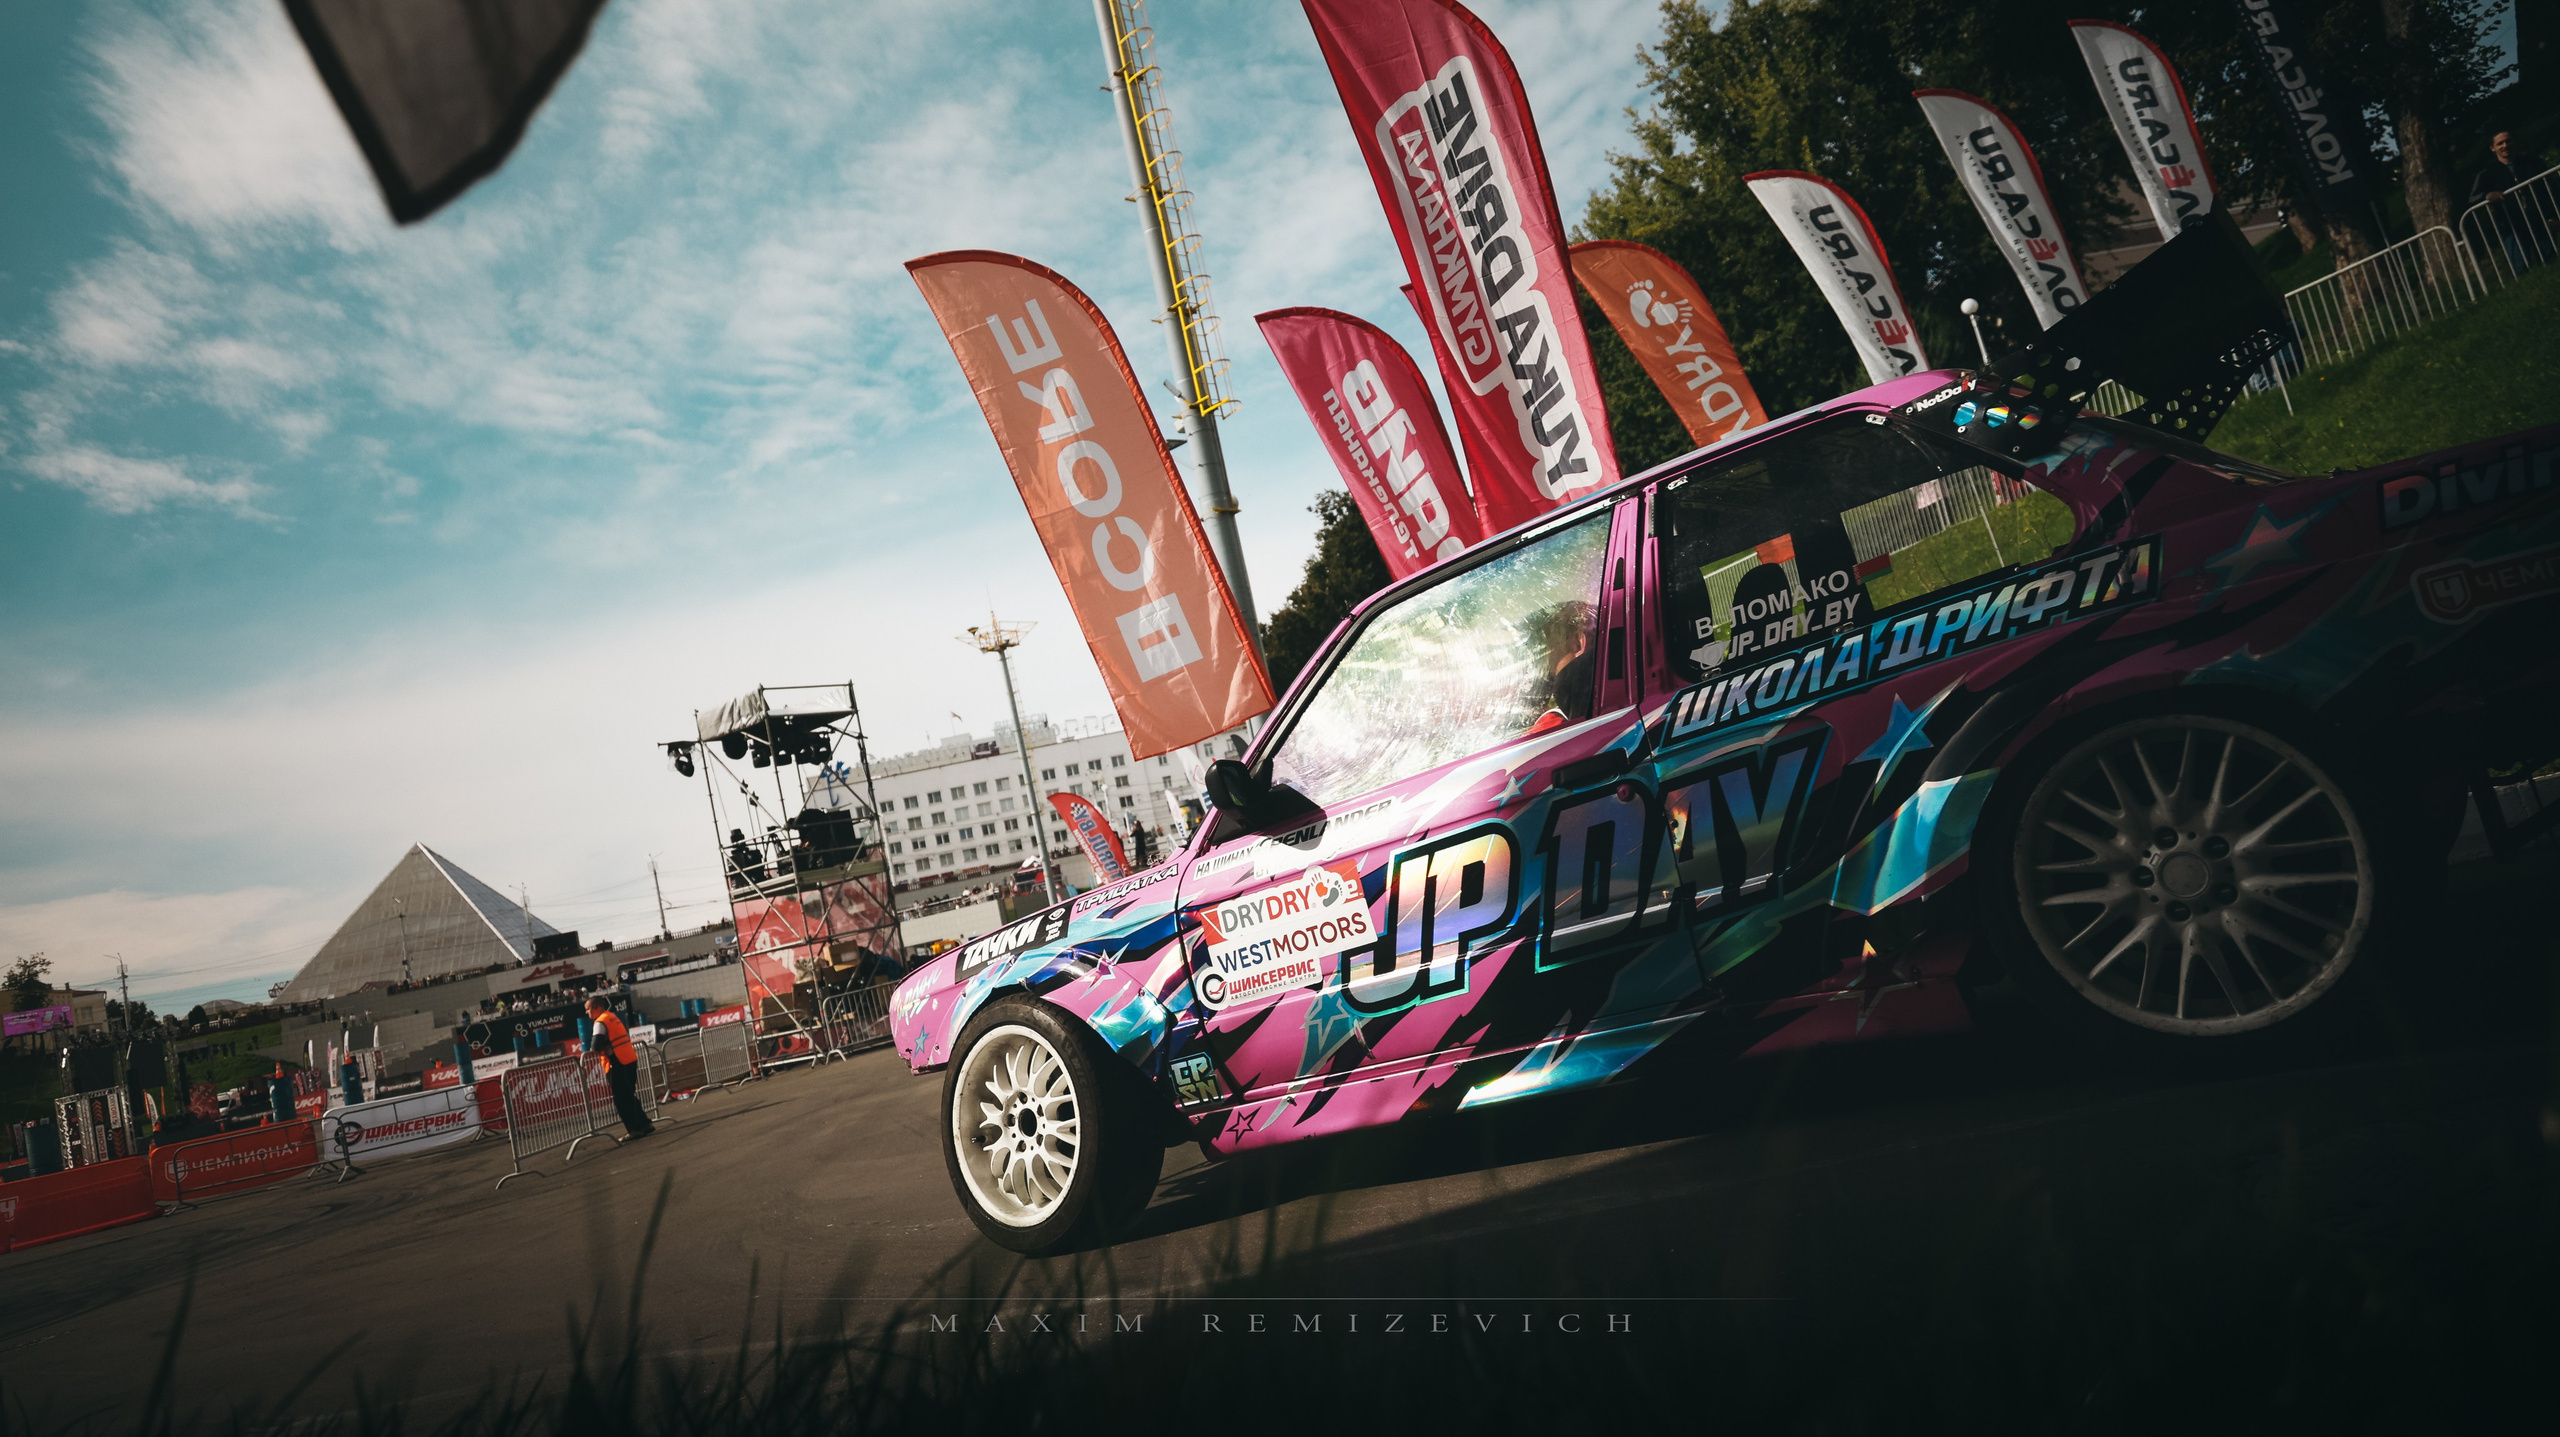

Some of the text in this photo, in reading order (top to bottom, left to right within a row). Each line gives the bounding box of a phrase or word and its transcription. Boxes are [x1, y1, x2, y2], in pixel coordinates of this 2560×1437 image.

[1916, 378, 1977, 413] NotDaily
[1729, 570, 1850, 629] ЛОМАКО
[1669, 541, 2152, 739] ШКОЛА ДРИФТА
[1076, 863, 1179, 914] ТРИЦАТКА
[1196, 863, 1211, 879] НА
[1346, 745, 1810, 1006] JP DAY
[1221, 885, 1311, 933] DRYDRY
[962, 914, 1046, 972] ТАЧКИ
[1217, 912, 1367, 974] WESTMOTORS
[1229, 958, 1316, 995] ШИНСЕРВИС
[1230, 971, 1318, 1001] АВТОСЕРВИСНЫЕ ЦЕНТРЫ
[527, 1018, 548, 1029] YUKA
[706, 1011, 741, 1027] YUKA
[365, 1109, 467, 1140] ШИНСЕРВИС
[192, 1141, 302, 1174] ЧЕМПИОНАТ
